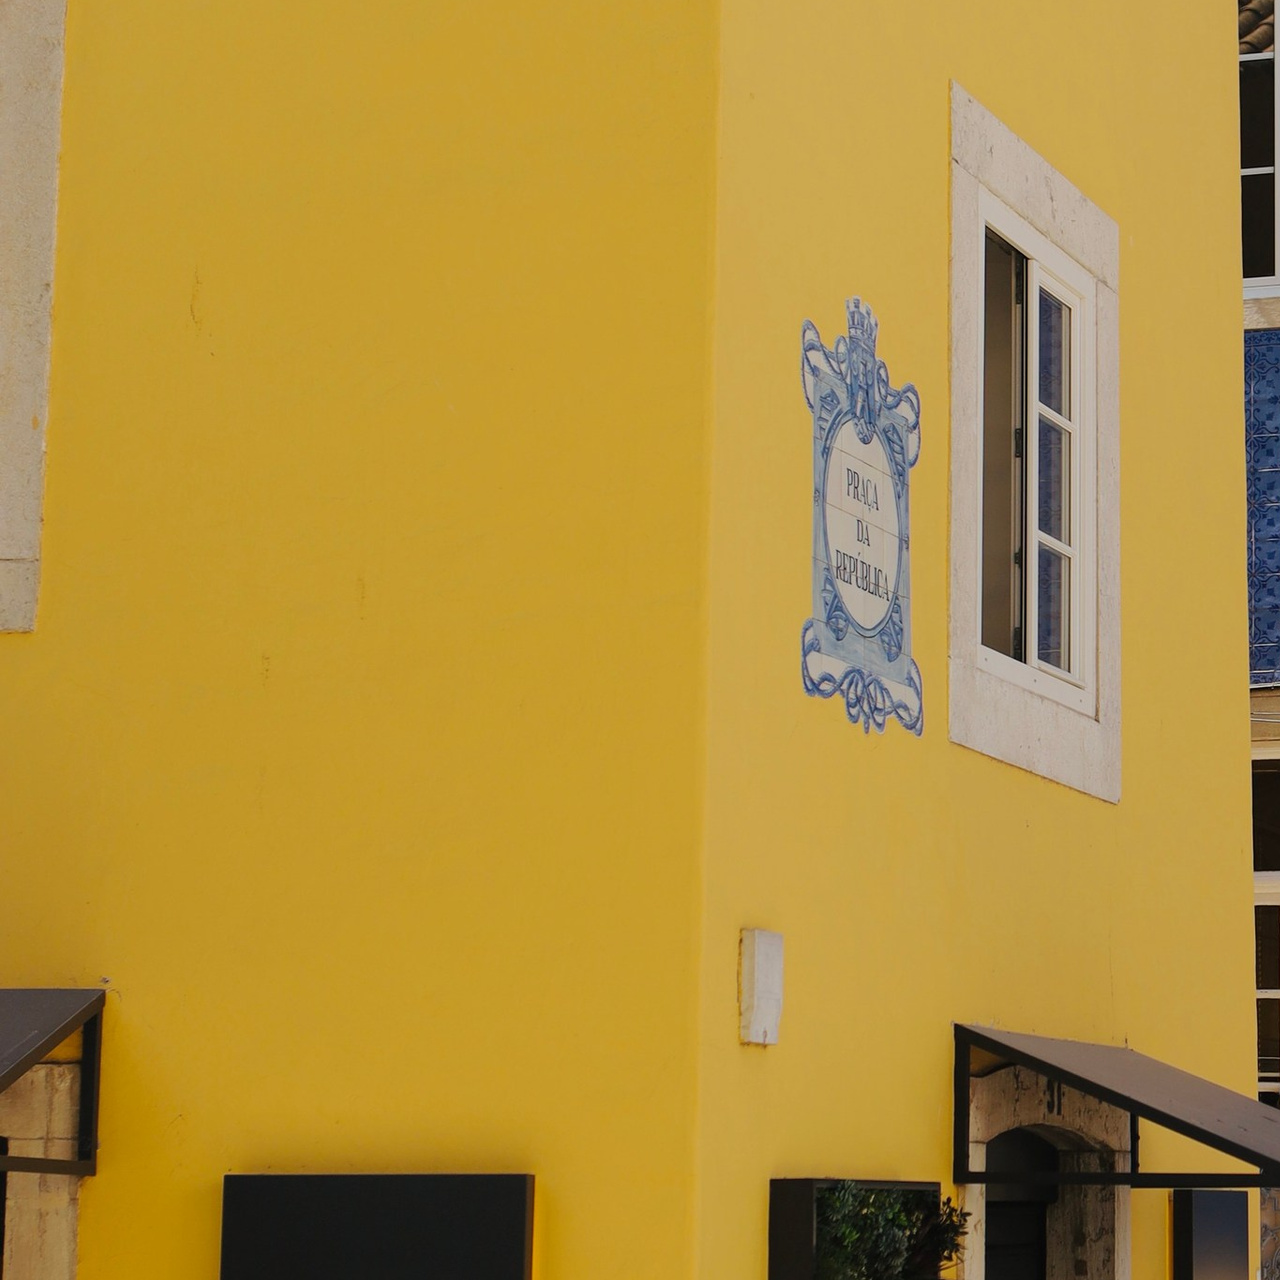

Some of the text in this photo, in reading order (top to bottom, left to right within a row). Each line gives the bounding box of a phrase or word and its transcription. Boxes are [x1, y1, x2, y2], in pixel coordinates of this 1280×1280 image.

[846, 467, 879, 513] PRAÇA
[856, 519, 871, 547] DA
[835, 549, 890, 602] REPÚBLICA
